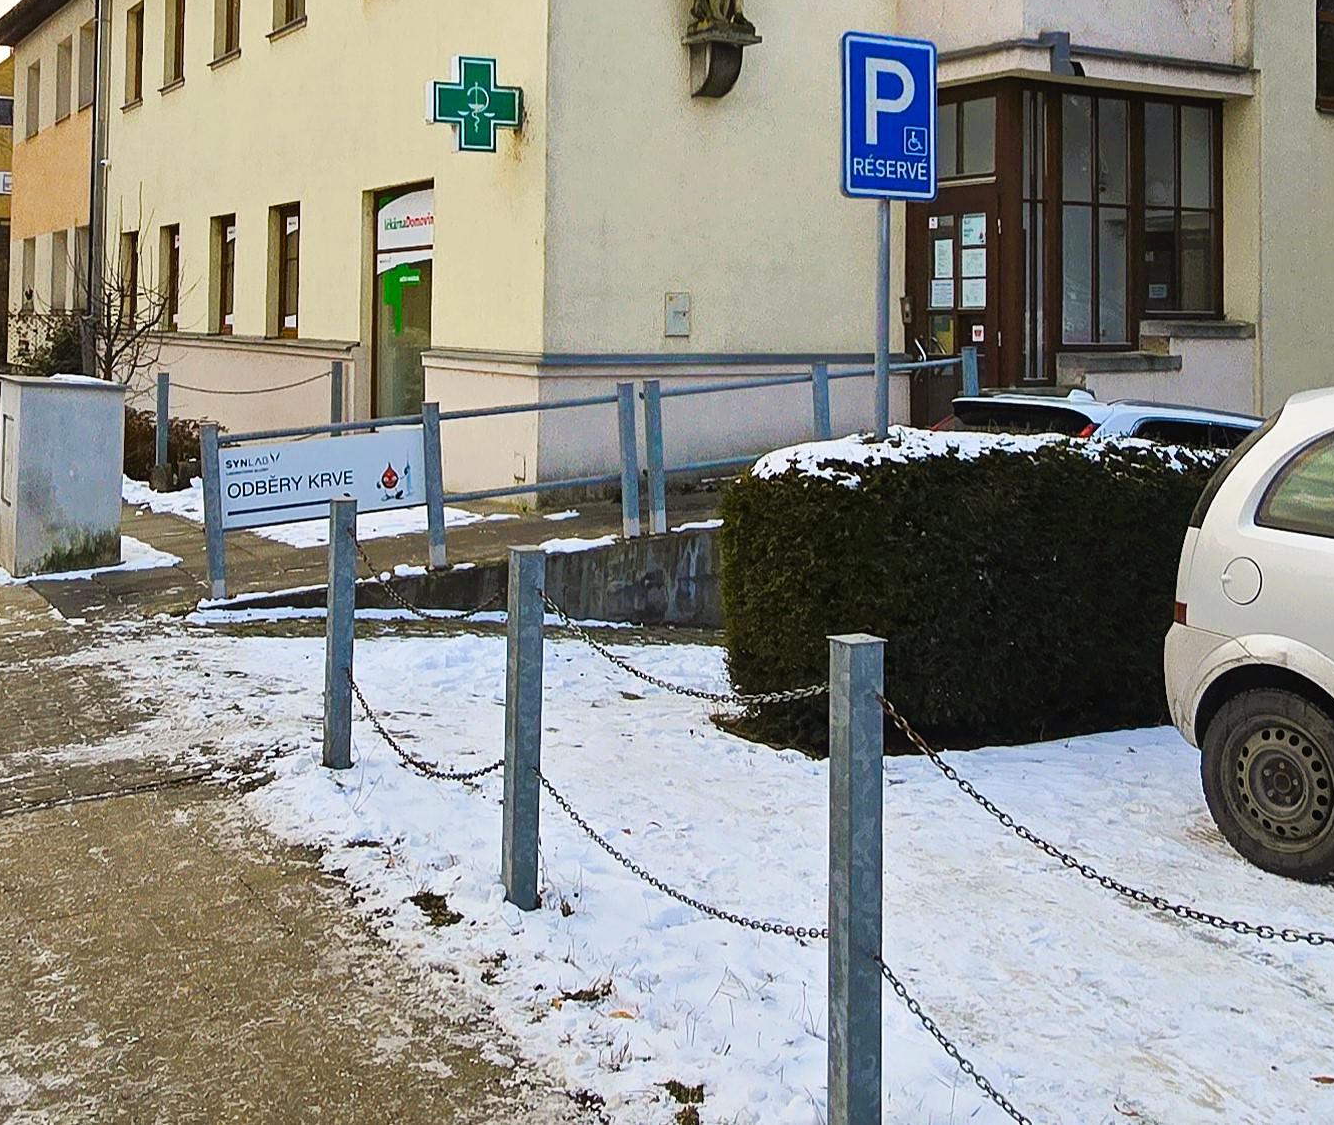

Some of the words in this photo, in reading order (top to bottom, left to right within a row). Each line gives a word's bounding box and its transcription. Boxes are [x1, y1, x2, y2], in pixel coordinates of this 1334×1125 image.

[865, 56, 916, 145] P
[853, 153, 928, 181] RÉSERVÉ
[227, 475, 303, 499] ODBĚRY
[308, 469, 354, 489] KRVE
